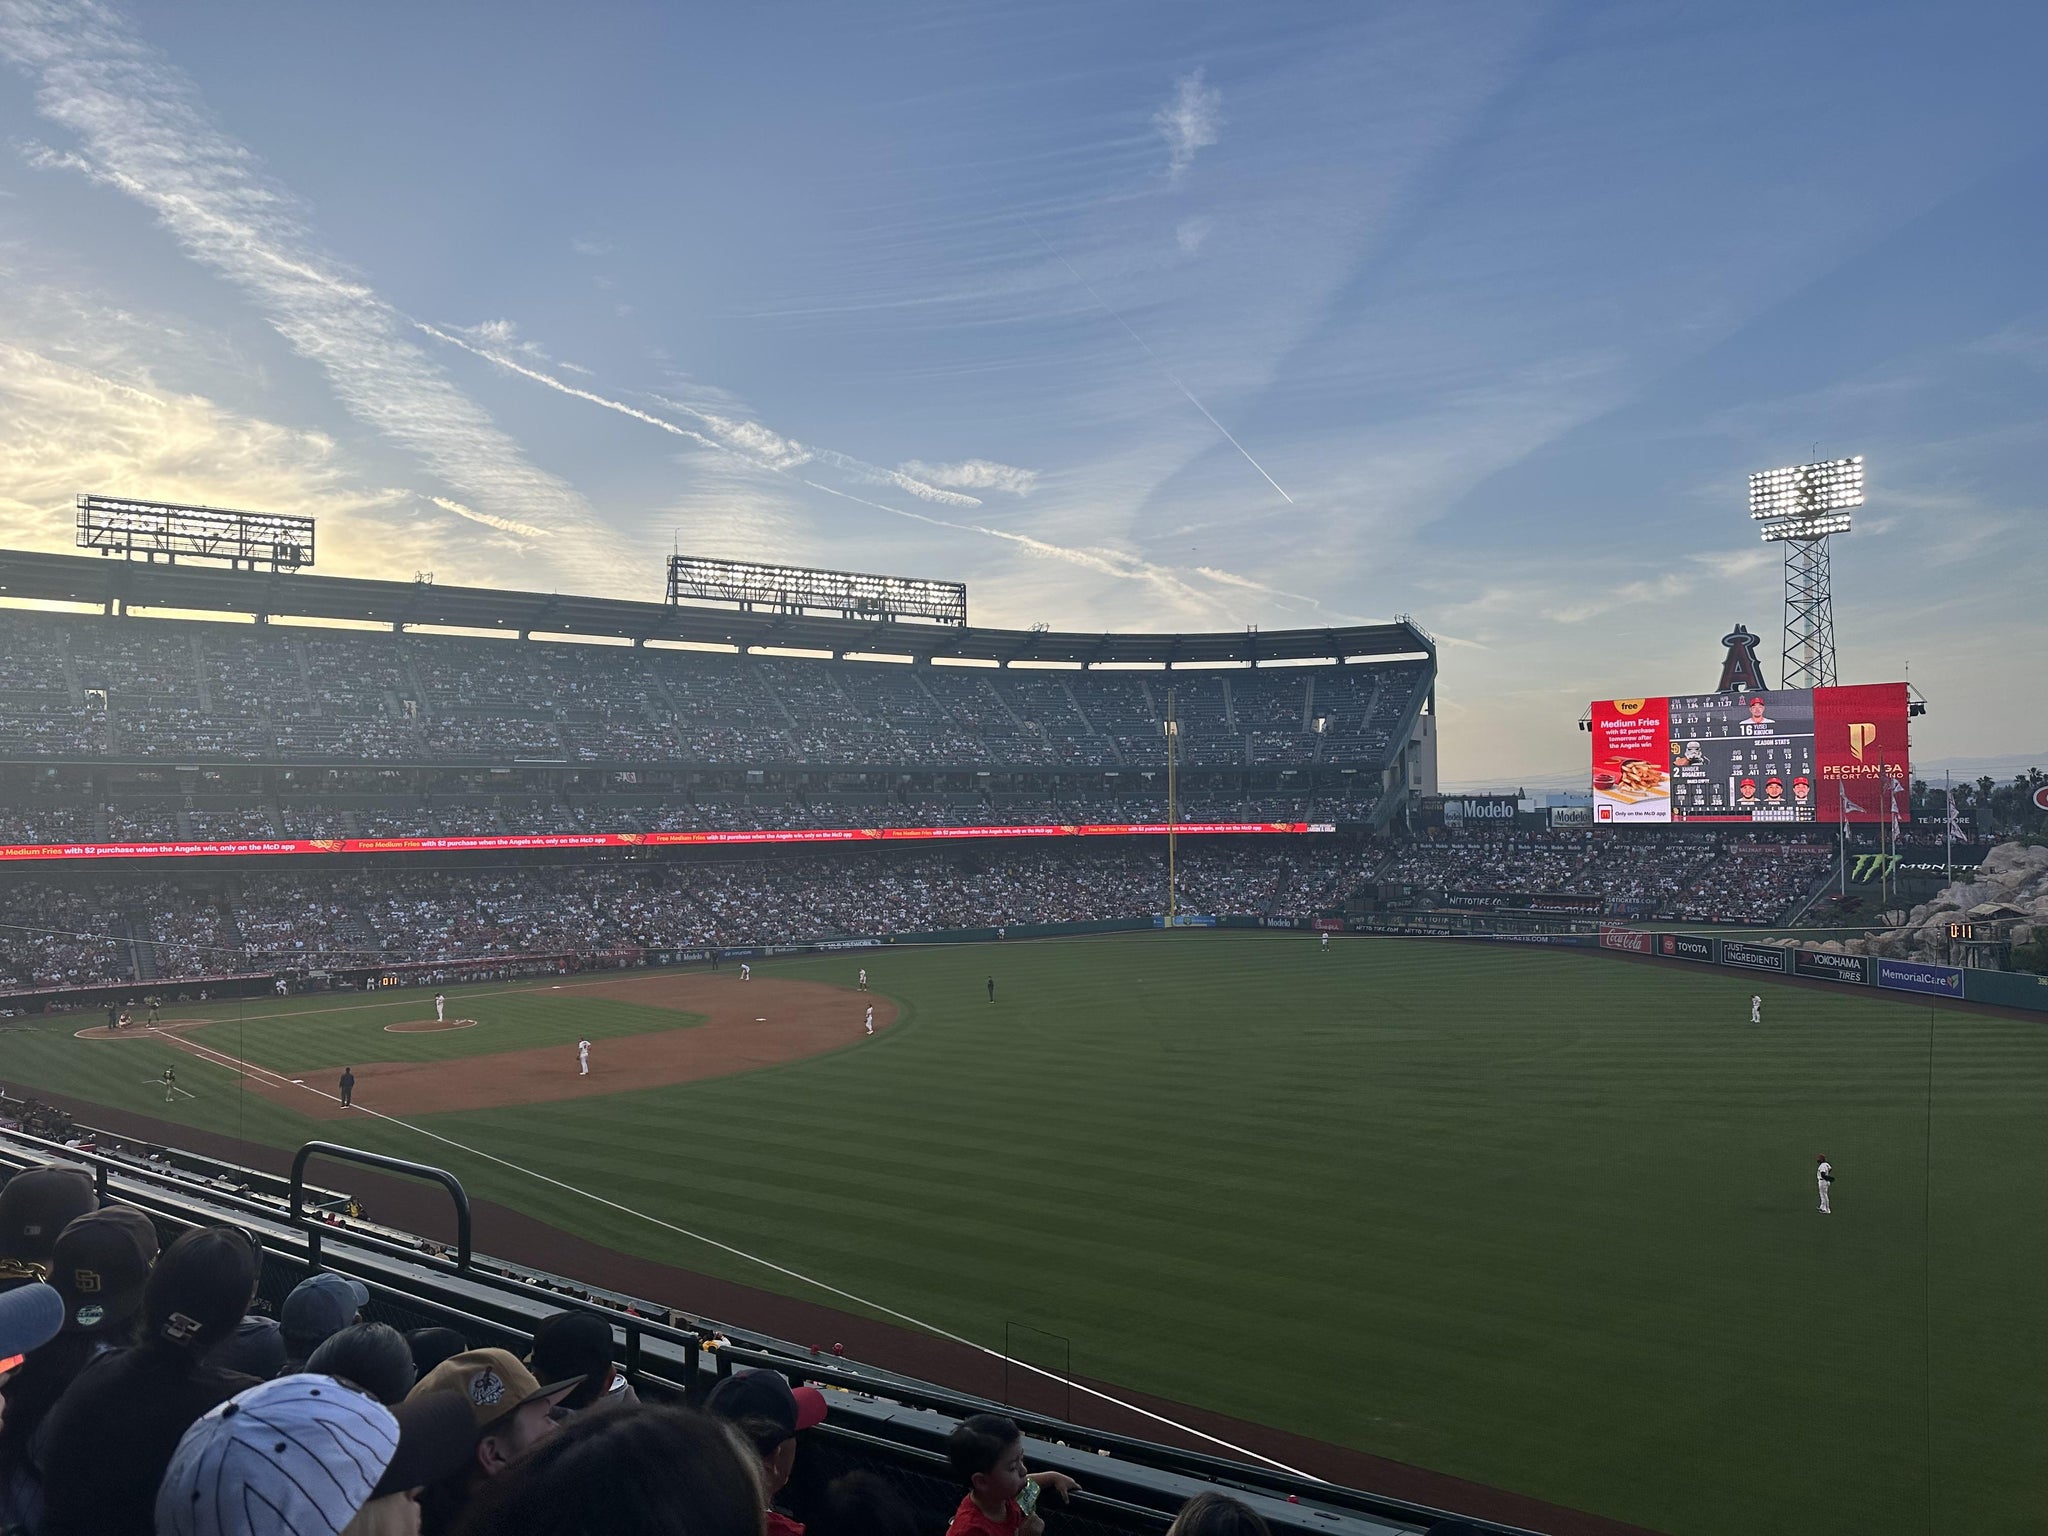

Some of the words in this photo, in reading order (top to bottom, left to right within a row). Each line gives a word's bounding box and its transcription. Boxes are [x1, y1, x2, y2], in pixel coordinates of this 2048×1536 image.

[1601, 720, 1636, 728] Medium
[1740, 725, 1752, 735] 16
[1673, 767, 1680, 777] 2
[1824, 764, 1902, 773] PECHANGA
[1464, 801, 1513, 818] Modelo
[1557, 811, 1588, 822] Modelo
[1268, 918, 1290, 927] Modelo
[1677, 942, 1707, 954] TOYOTA
[1727, 951, 1779, 966] INGREDIENTS
[1812, 955, 1861, 969] YOKOHAMA
[1839, 970, 1861, 982] TIRES
[1882, 969, 1946, 986] MemorialCare
